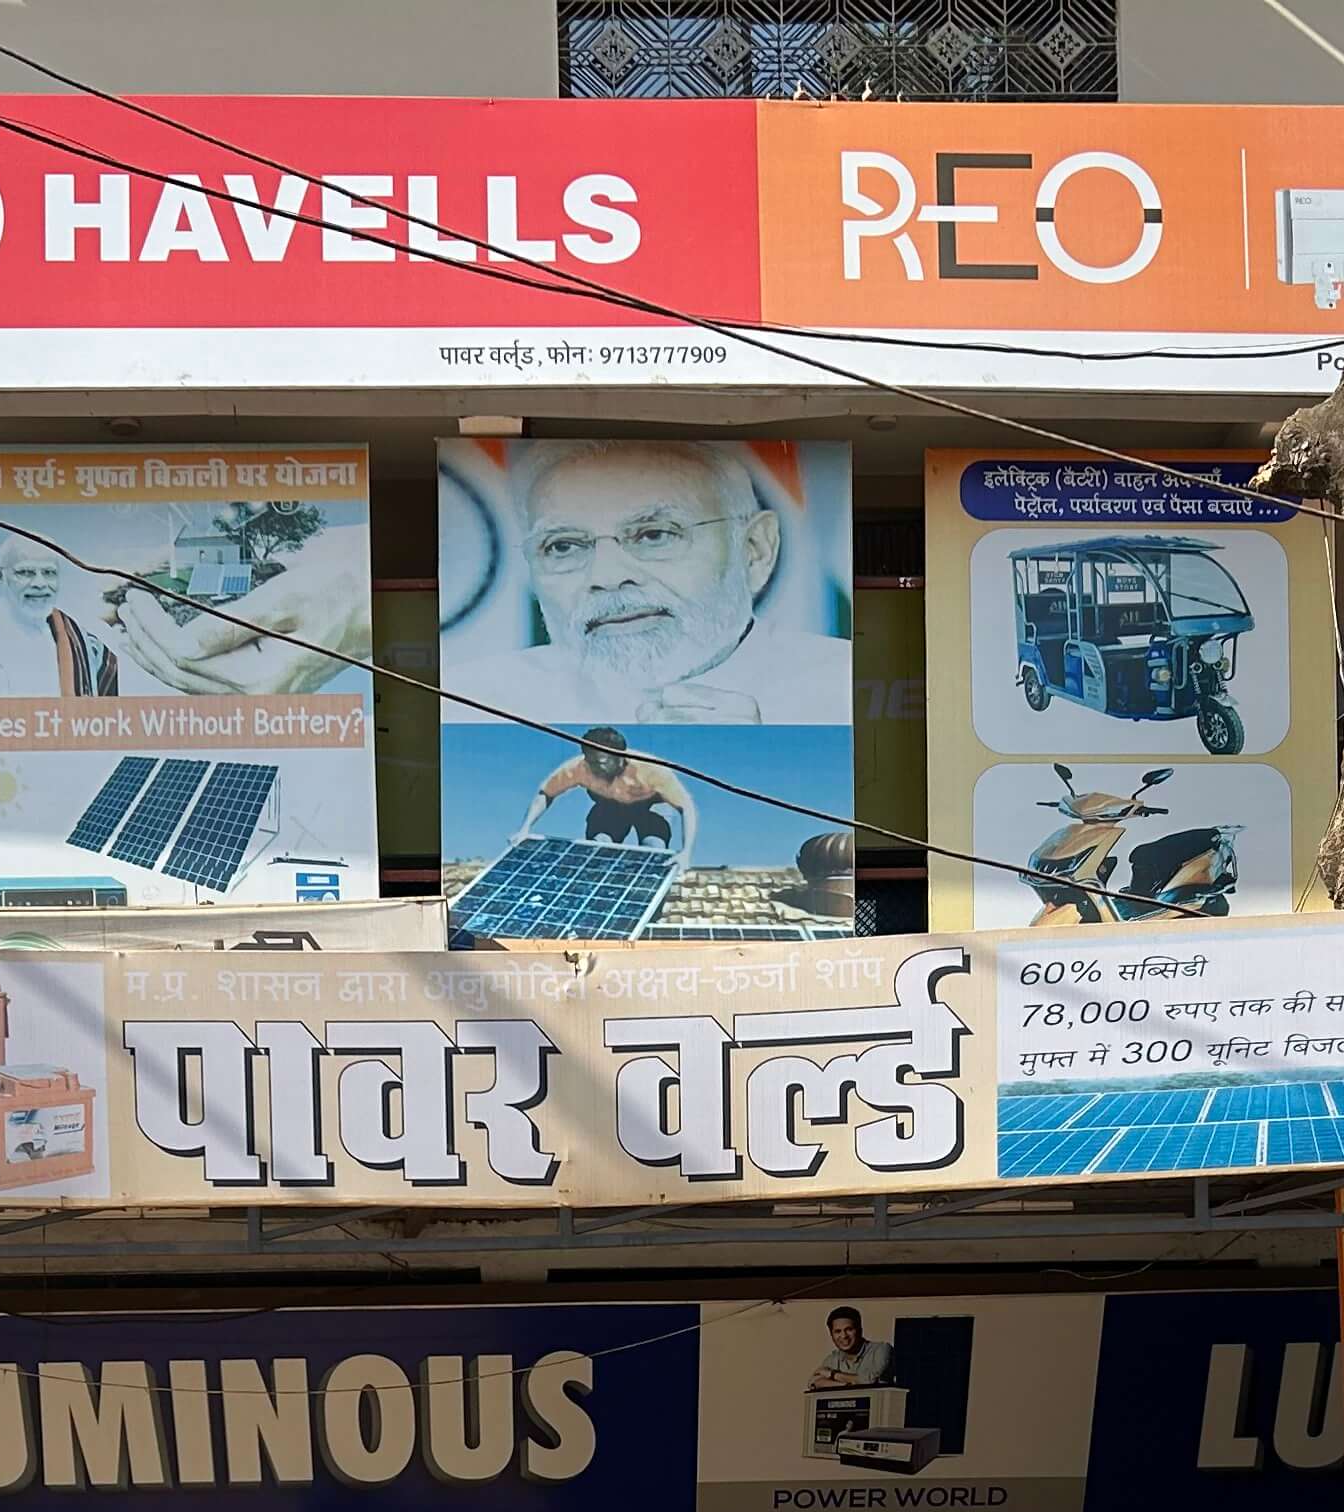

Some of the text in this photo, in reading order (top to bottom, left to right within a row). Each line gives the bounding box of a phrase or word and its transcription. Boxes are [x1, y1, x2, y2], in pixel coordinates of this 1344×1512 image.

[43, 173, 642, 265] HAVELLS
[841, 150, 1164, 284] REO
[439, 342, 485, 367] पावर
[599, 344, 728, 367] 9713777909
[144, 459, 228, 488] बिजली
[235, 464, 270, 486] घर
[276, 458, 358, 486] योजना
[1114, 470, 1156, 491] वाहन
[1069, 492, 1137, 515] पर्यावरण
[1170, 493, 1203, 515] पैसा
[33, 710, 63, 737] It
[71, 707, 132, 736] work
[138, 706, 245, 736] Without
[254, 706, 365, 744] Battery?
[215, 969, 323, 1002] शासन
[336, 968, 409, 1004] द्वारा
[1019, 954, 1209, 987] 60% सब्सिडी
[1021, 998, 1150, 1029] 78,000
[1164, 998, 1220, 1021] रुपए
[1228, 996, 1274, 1019] तक
[1281, 990, 1320, 1015] की
[123, 946, 975, 1187] पावर वर्ल्ड
[1018, 1048, 1076, 1077] मुफ्त
[1087, 1042, 1114, 1067] में
[1120, 1038, 1193, 1066] 300
[1206, 1036, 1274, 1068] यूनिट
[773, 1486, 1009, 1511] POWER WORLD
